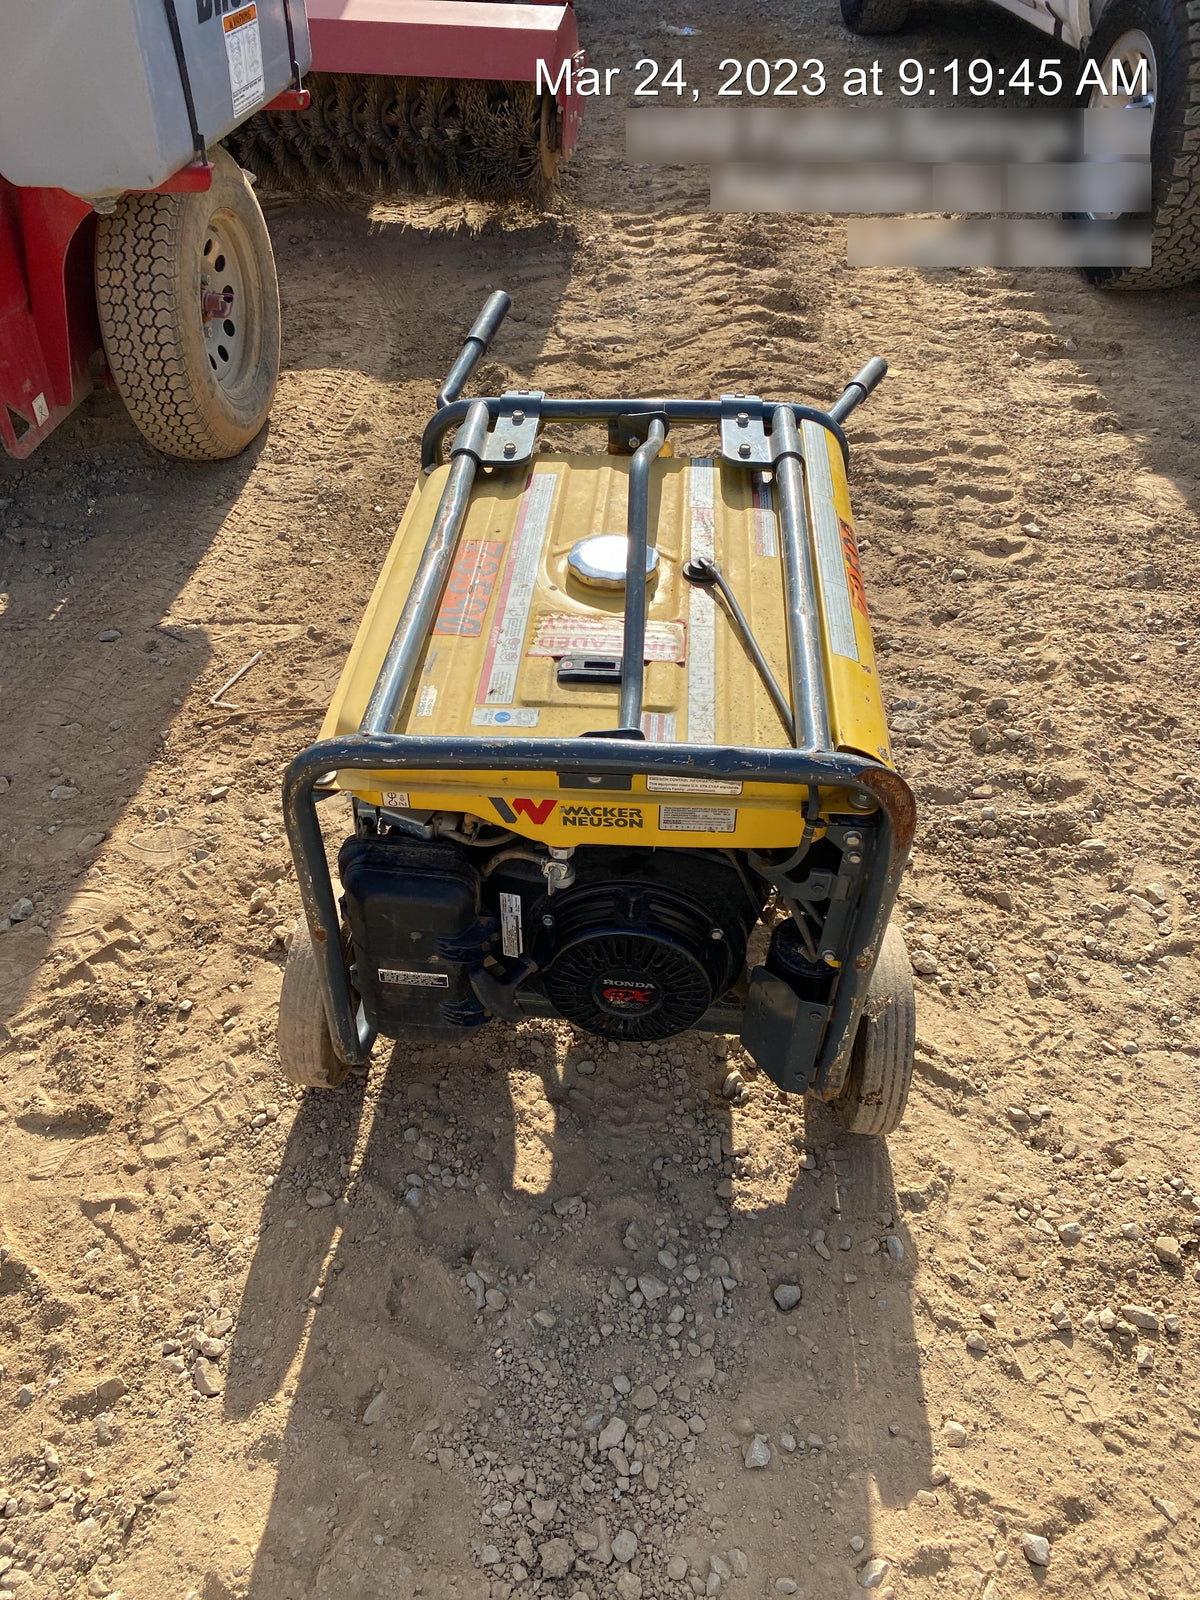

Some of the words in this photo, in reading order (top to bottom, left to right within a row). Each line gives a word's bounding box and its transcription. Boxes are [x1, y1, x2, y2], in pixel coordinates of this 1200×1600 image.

[561, 807, 643, 818] WACKER
[562, 816, 644, 828] NEUSON
[603, 979, 656, 989] HONDA
